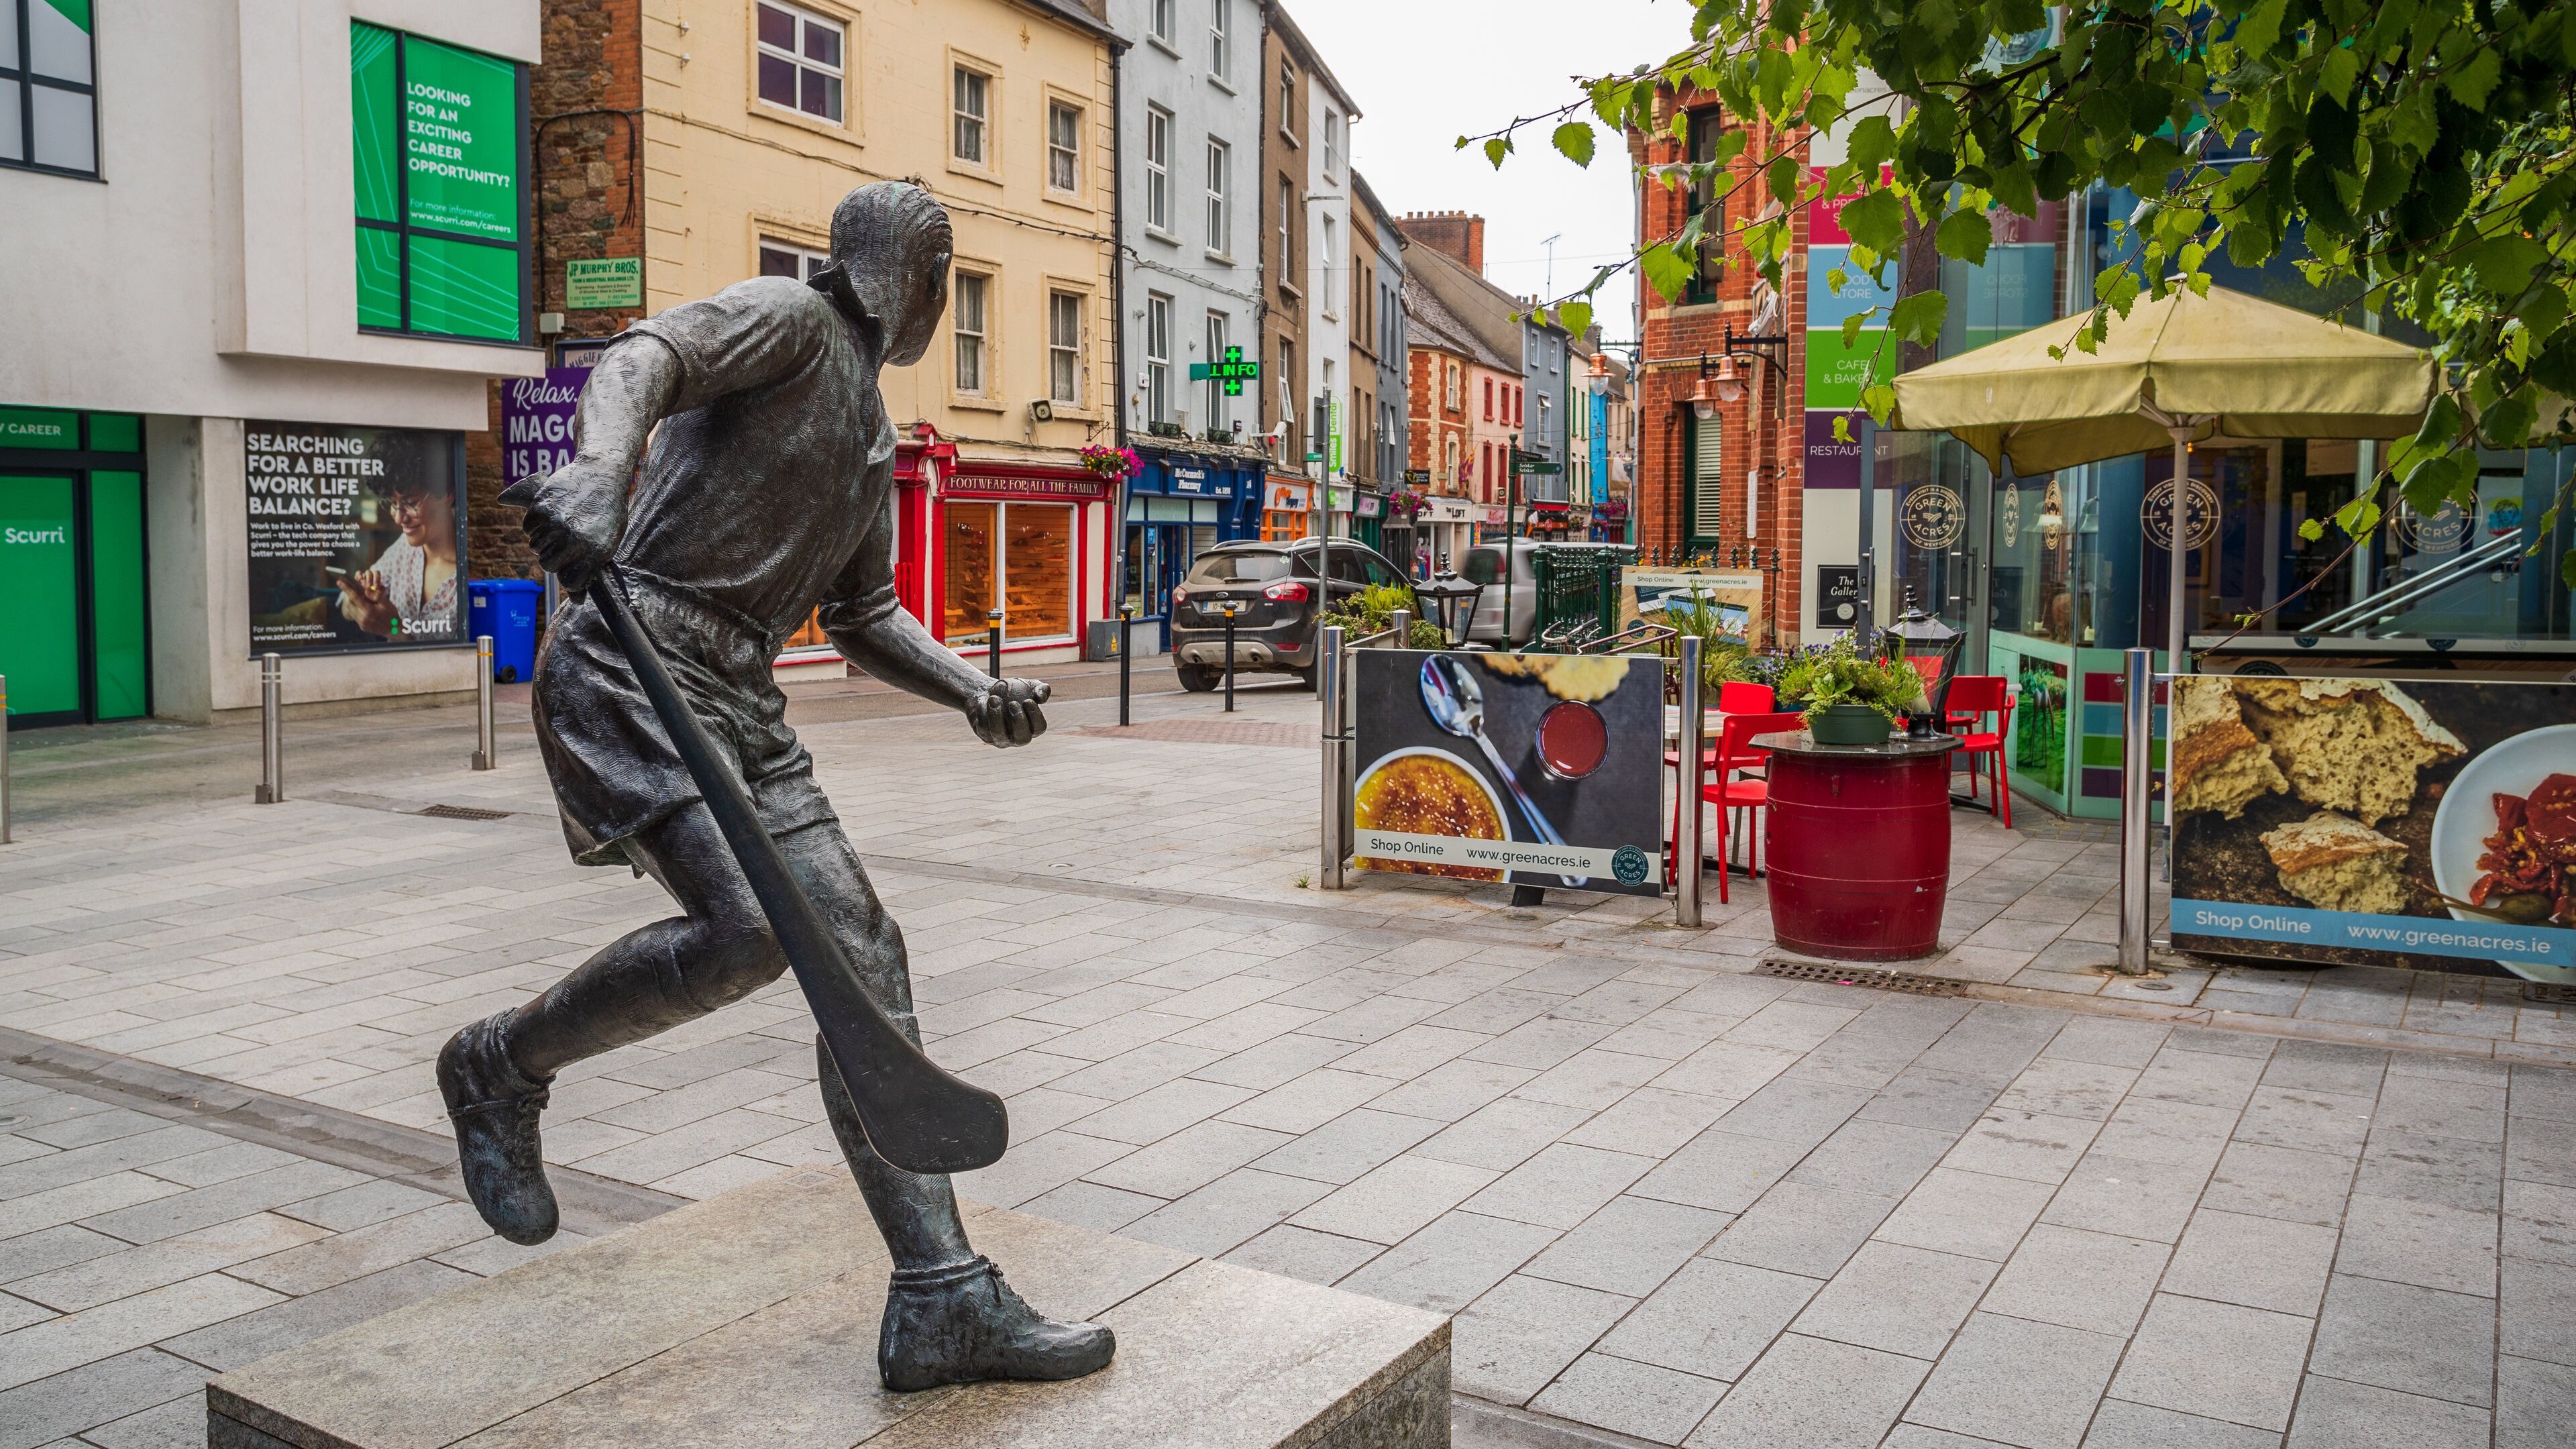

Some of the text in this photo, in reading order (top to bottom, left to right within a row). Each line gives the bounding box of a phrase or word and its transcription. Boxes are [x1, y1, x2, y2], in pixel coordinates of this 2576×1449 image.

[407, 81, 471, 107] LOOKING
[408, 101, 458, 122] FOR AN
[408, 119, 472, 144] EXCITING
[408, 139, 462, 160] CAREER
[409, 158, 510, 188] OPPORTUNITY?
[410, 199, 496, 220] For more information:
[1822, 199, 1829, 209] &
[410, 211, 511, 233] www.scurri.com/careers
[569, 261, 639, 277] JP MURPHY BROS.
[1846, 275, 1870, 285] OOD
[569, 352, 596, 368] MAGGIE
[1823, 374, 1880, 384] & BAKEY
[8, 423, 61, 435] CAREER
[248, 433, 364, 455] SEARCHING
[1330, 437, 1338, 467] Smiles
[1811, 445, 1888, 455] RESTAURNT
[248, 455, 384, 476] FOR A BETTER
[512, 449, 570, 477] IS BA
[1175, 468, 1205, 480] McCormack's
[248, 476, 359, 495] WORK LIFE
[951, 477, 1099, 494] FOOTWEAR FOR ALL THE FAMILY
[1178, 480, 1201, 492] Pharmacy
[249, 496, 352, 515] BALANCE?
[1915, 498, 1951, 511] GREEN
[2159, 493, 2204, 508] GREN
[1452, 507, 1465, 518] LOFT
[280, 522, 293, 530] live
[1915, 523, 1949, 536] ACRES
[2157, 521, 2200, 535] ACES
[2412, 521, 2461, 538] ACRES
[5, 526, 65, 544] Scurri
[251, 541, 269, 549] gives
[1839, 576, 1854, 585] The
[284, 623, 324, 631] information:
[401, 614, 451, 635] Scurri
[253, 631, 337, 641] www.scurri.com/careers
[1371, 839, 1591, 868] Shop Online www.greenacres.ie
[1620, 854, 1642, 863] GREEN
[1619, 869, 1641, 878] ACRES
[2195, 910, 2551, 953] Shop Online www.greenacres.ie
